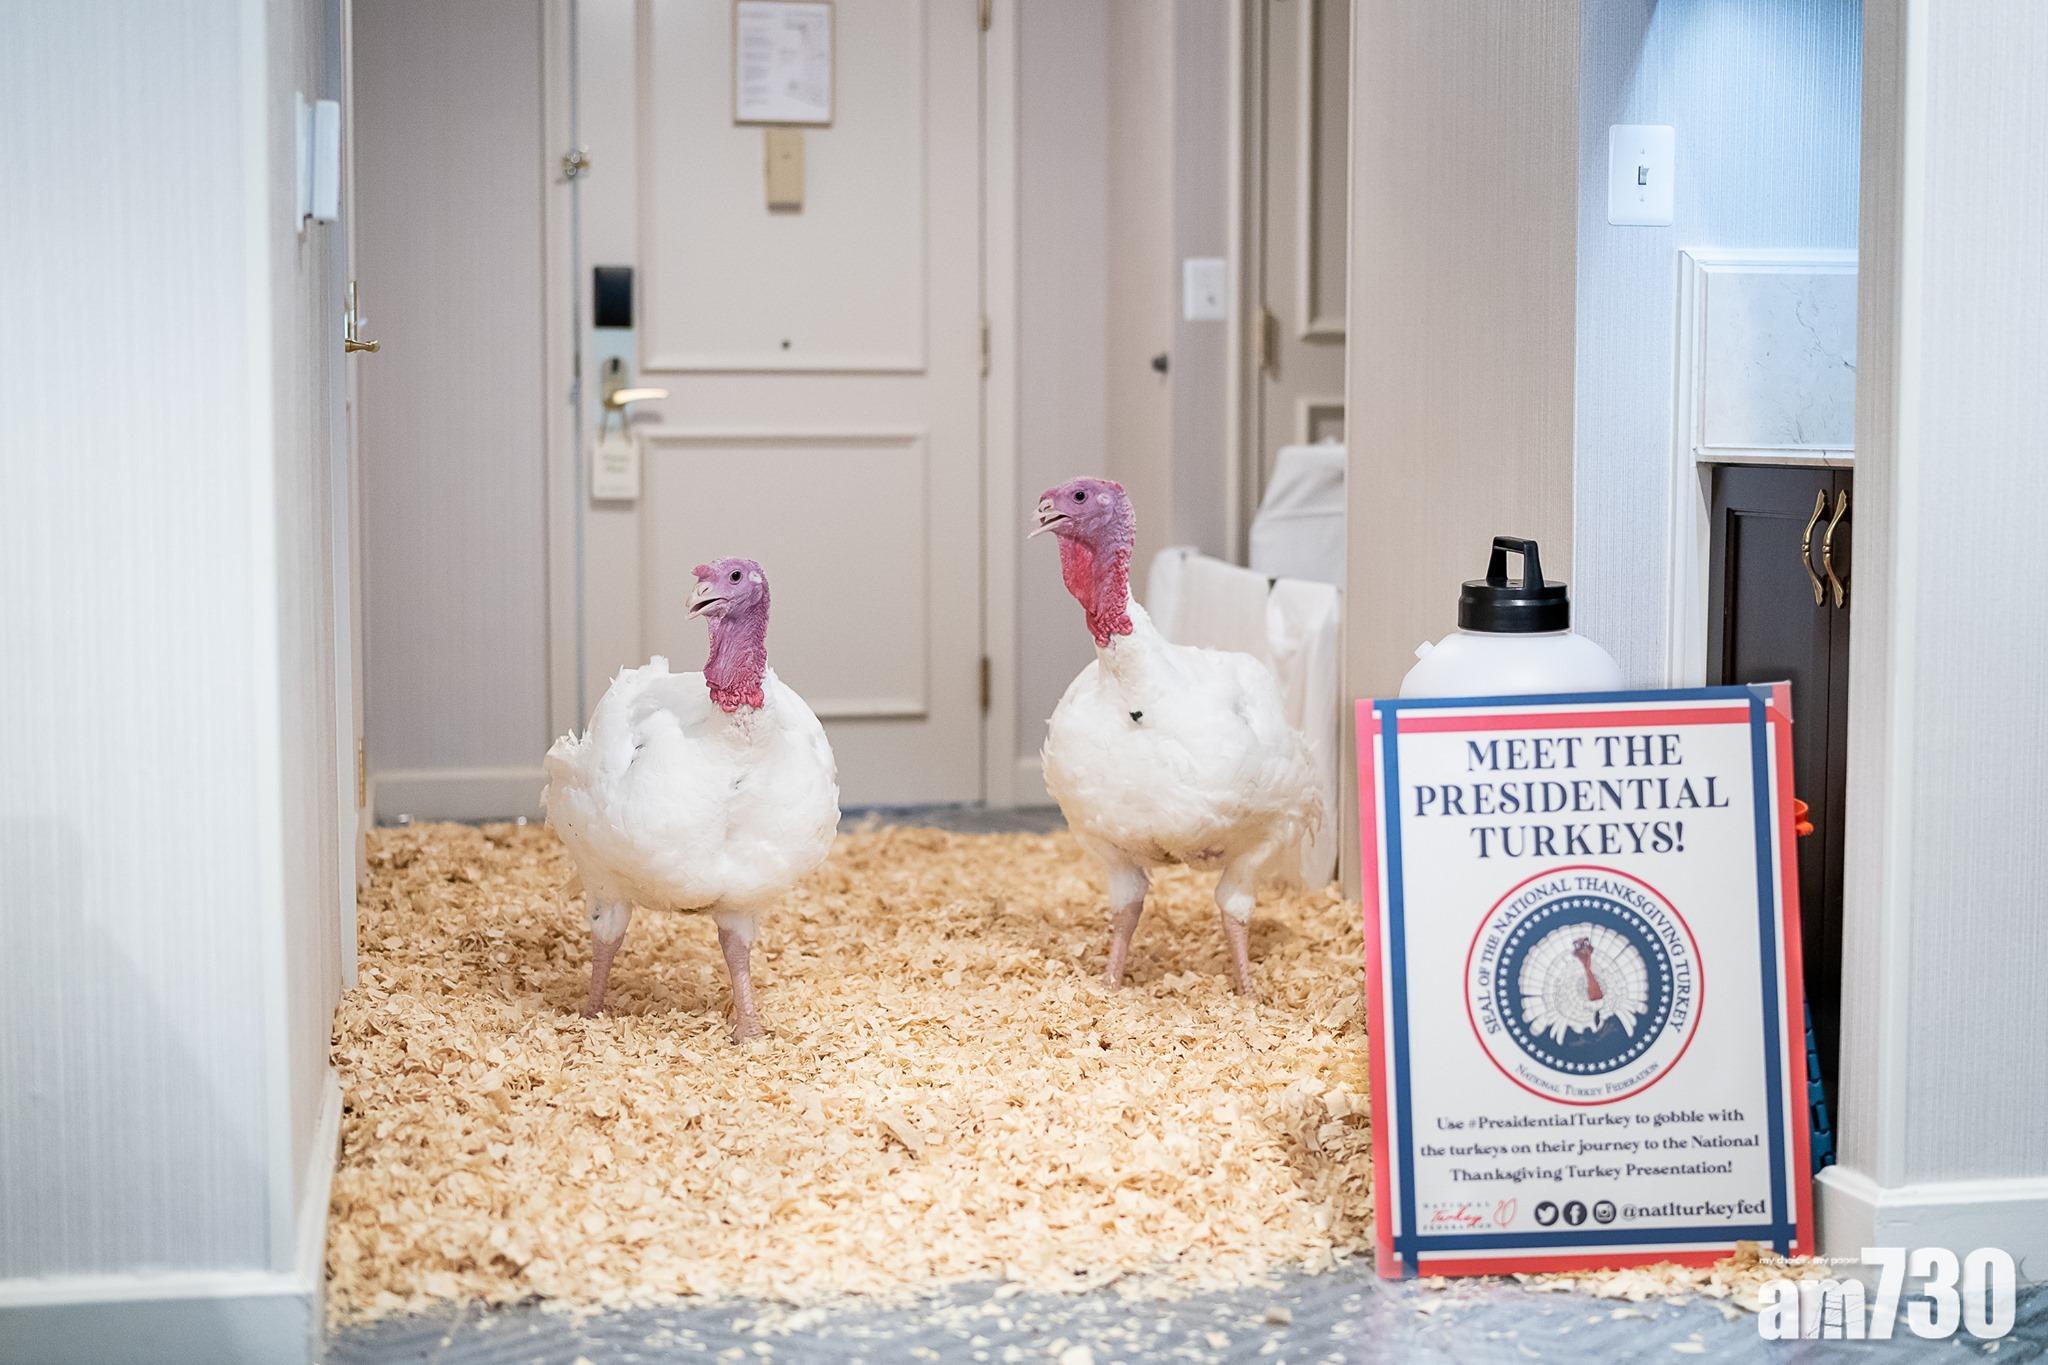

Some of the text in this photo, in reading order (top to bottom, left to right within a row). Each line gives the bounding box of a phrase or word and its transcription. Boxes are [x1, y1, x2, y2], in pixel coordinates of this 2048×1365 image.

[1467, 733, 1683, 772] MEET THE
[1414, 776, 1729, 817] PRESIDENTIAL
[1471, 821, 1685, 859] TURKEYS!
[1478, 877, 1690, 1034] SEAL OF THE NATIONAL THANKSGIVING TURKEY
[1437, 1109, 1744, 1130] Use #PresidentialTurkey to gobble with
[1421, 1135, 1760, 1158] the turkeys on their journey to the National
[1449, 1161, 1733, 1183] Thanksgiving Turkey Presentation!
[1621, 1199, 1766, 1220] @natlturkeyfed
